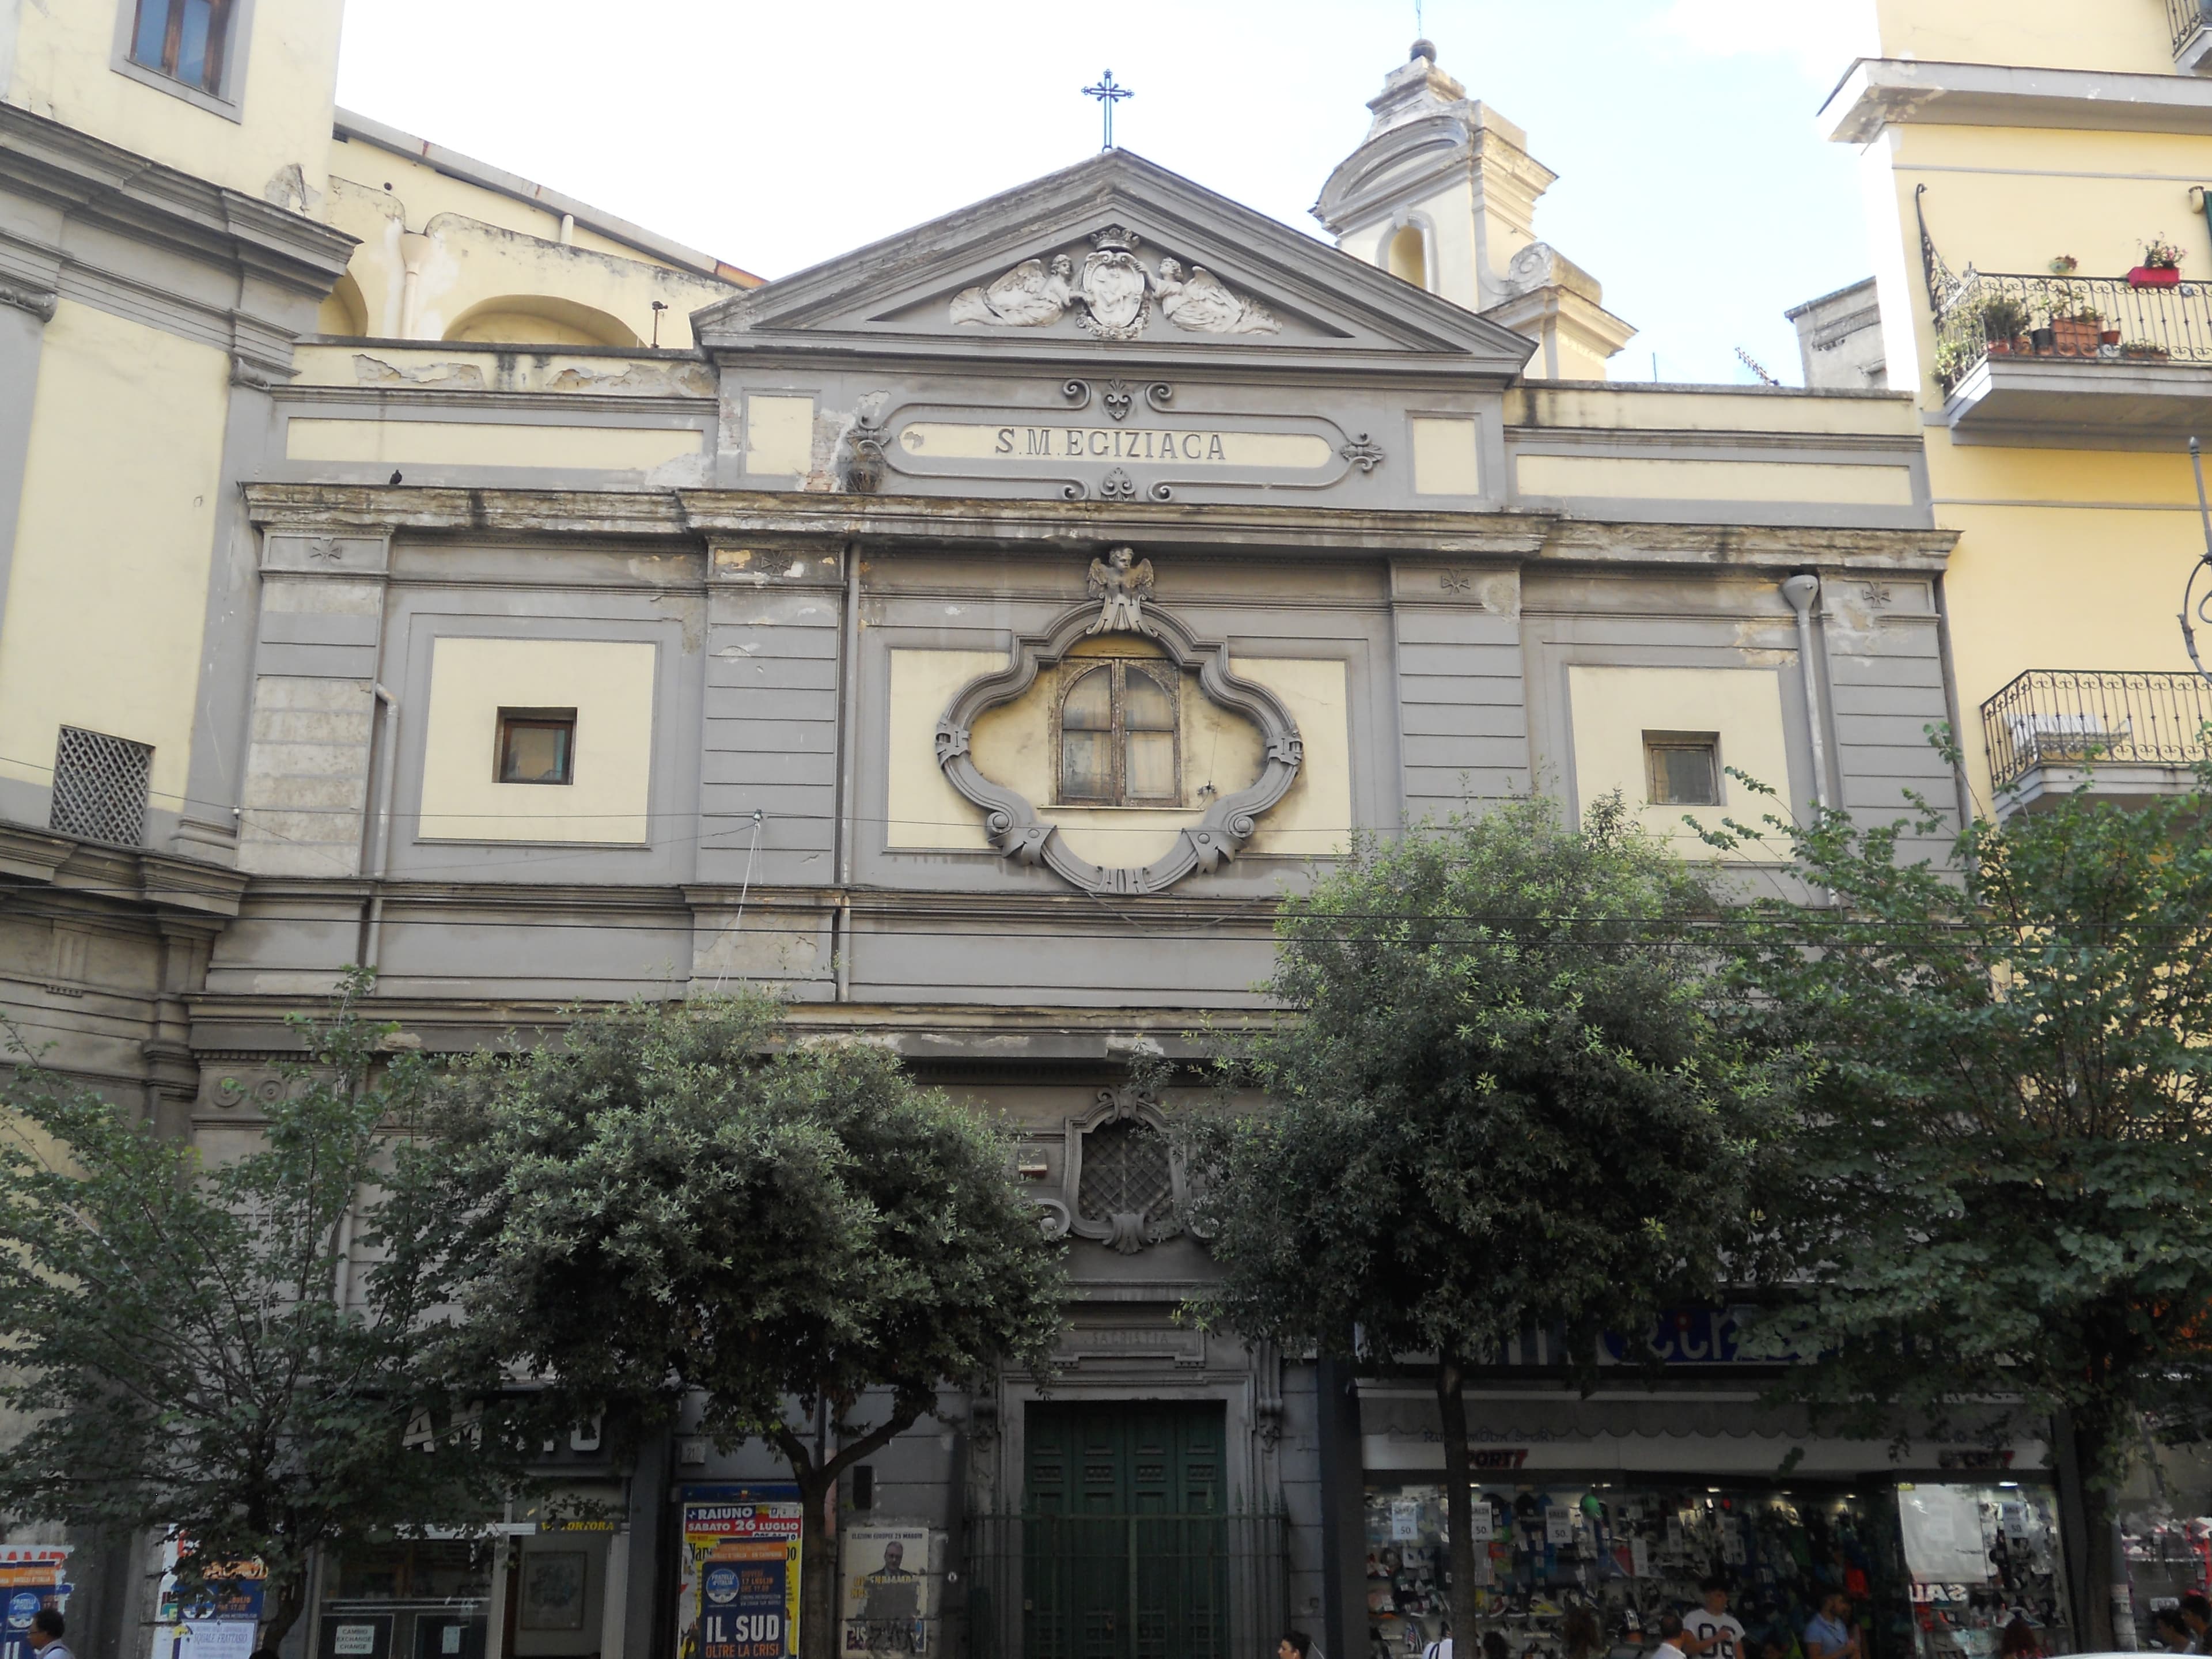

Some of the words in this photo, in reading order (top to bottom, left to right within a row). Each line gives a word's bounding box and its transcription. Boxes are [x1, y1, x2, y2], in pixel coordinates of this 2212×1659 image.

[698, 1506, 753, 1520] RAIUNO
[688, 1522, 730, 1531] SABATO
[734, 1520, 756, 1531] 26
[759, 1522, 799, 1531] LUGLIO
[706, 1615, 728, 1643] IL
[735, 1615, 779, 1642] SUD
[705, 1643, 735, 1658] OLTRE
[737, 1644, 750, 1658] LA
[753, 1643, 779, 1656] CRISI
